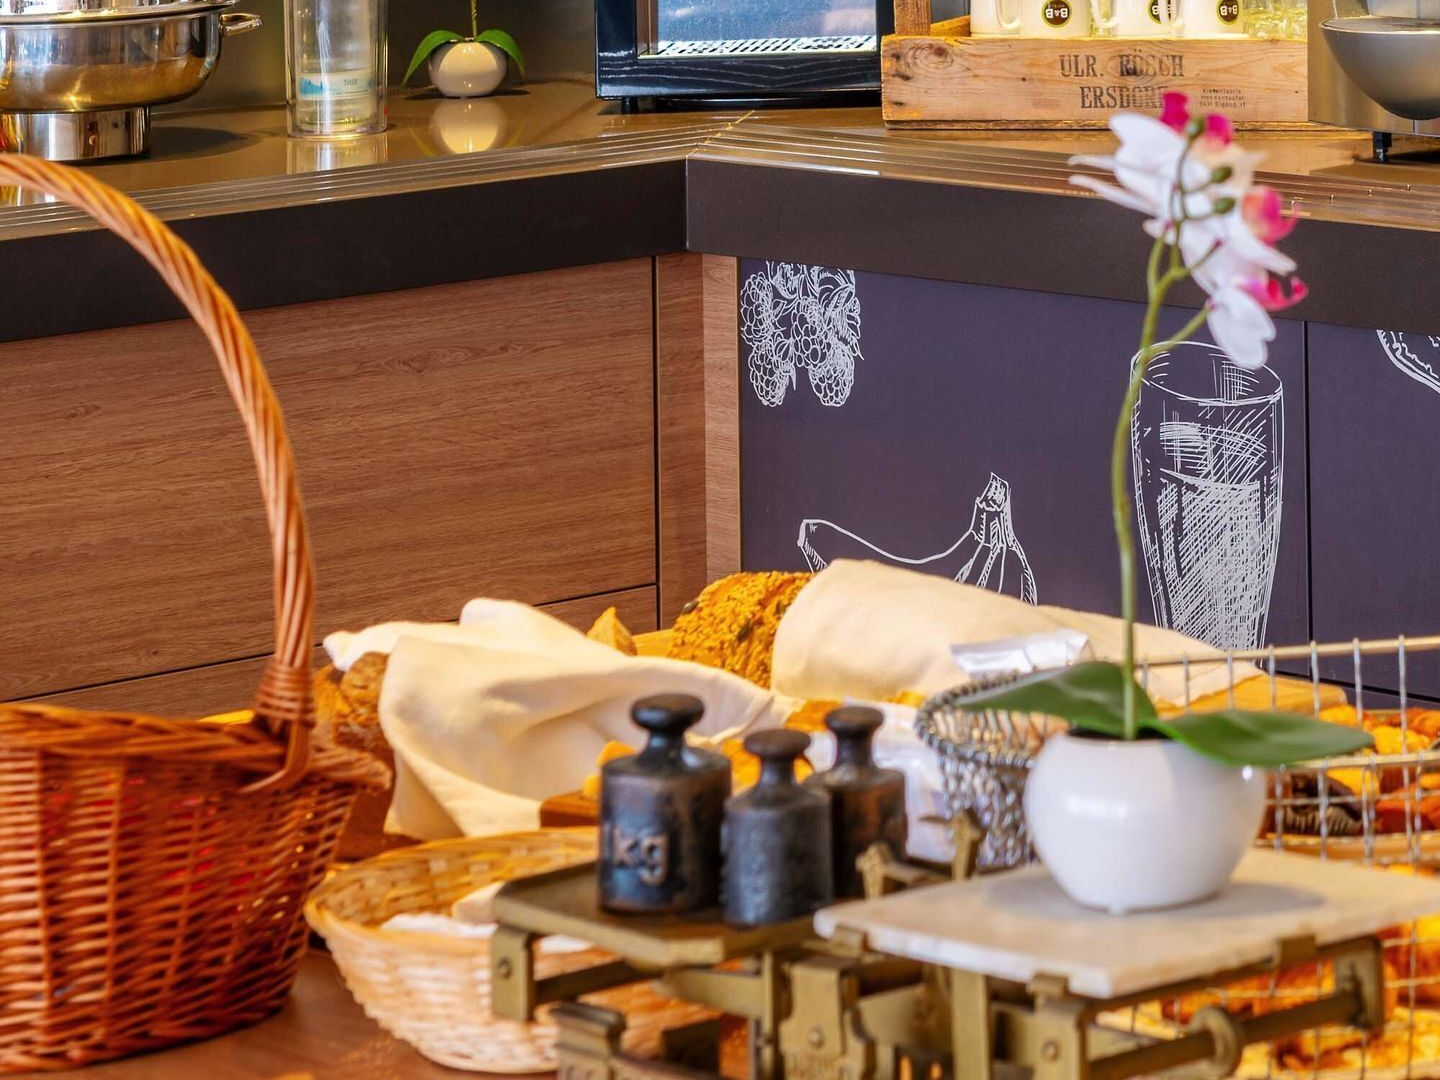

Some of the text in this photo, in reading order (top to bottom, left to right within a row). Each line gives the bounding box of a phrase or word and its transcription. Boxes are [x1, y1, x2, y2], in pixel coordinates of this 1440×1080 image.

[1059, 48, 1185, 78] ULR. RÖSCH
[343, 77, 358, 87] Still
